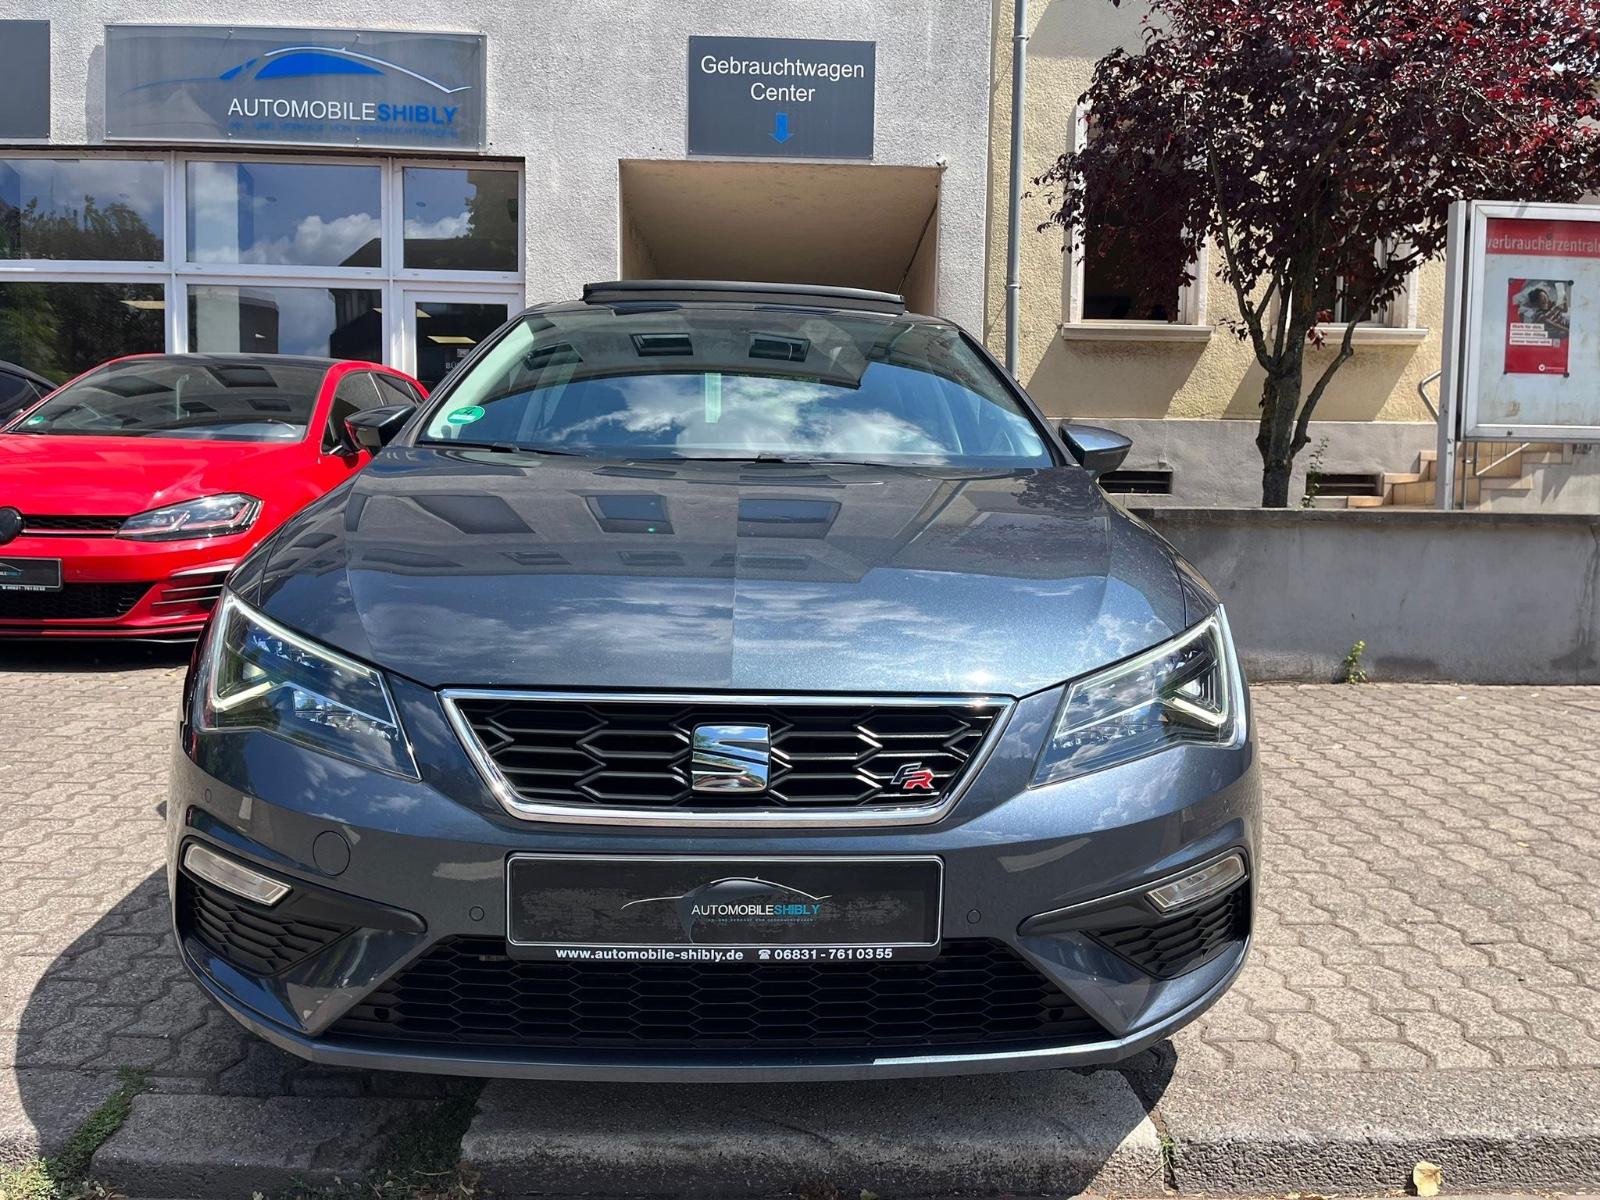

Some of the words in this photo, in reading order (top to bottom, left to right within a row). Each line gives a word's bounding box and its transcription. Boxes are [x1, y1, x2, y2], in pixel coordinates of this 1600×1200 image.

[700, 55, 865, 82] Gebrauchtwagen
[750, 82, 816, 102] Center
[890, 762, 935, 790] FR
[555, 949, 745, 962] www.automobile-shibly.de
[774, 948, 817, 960] 06831
